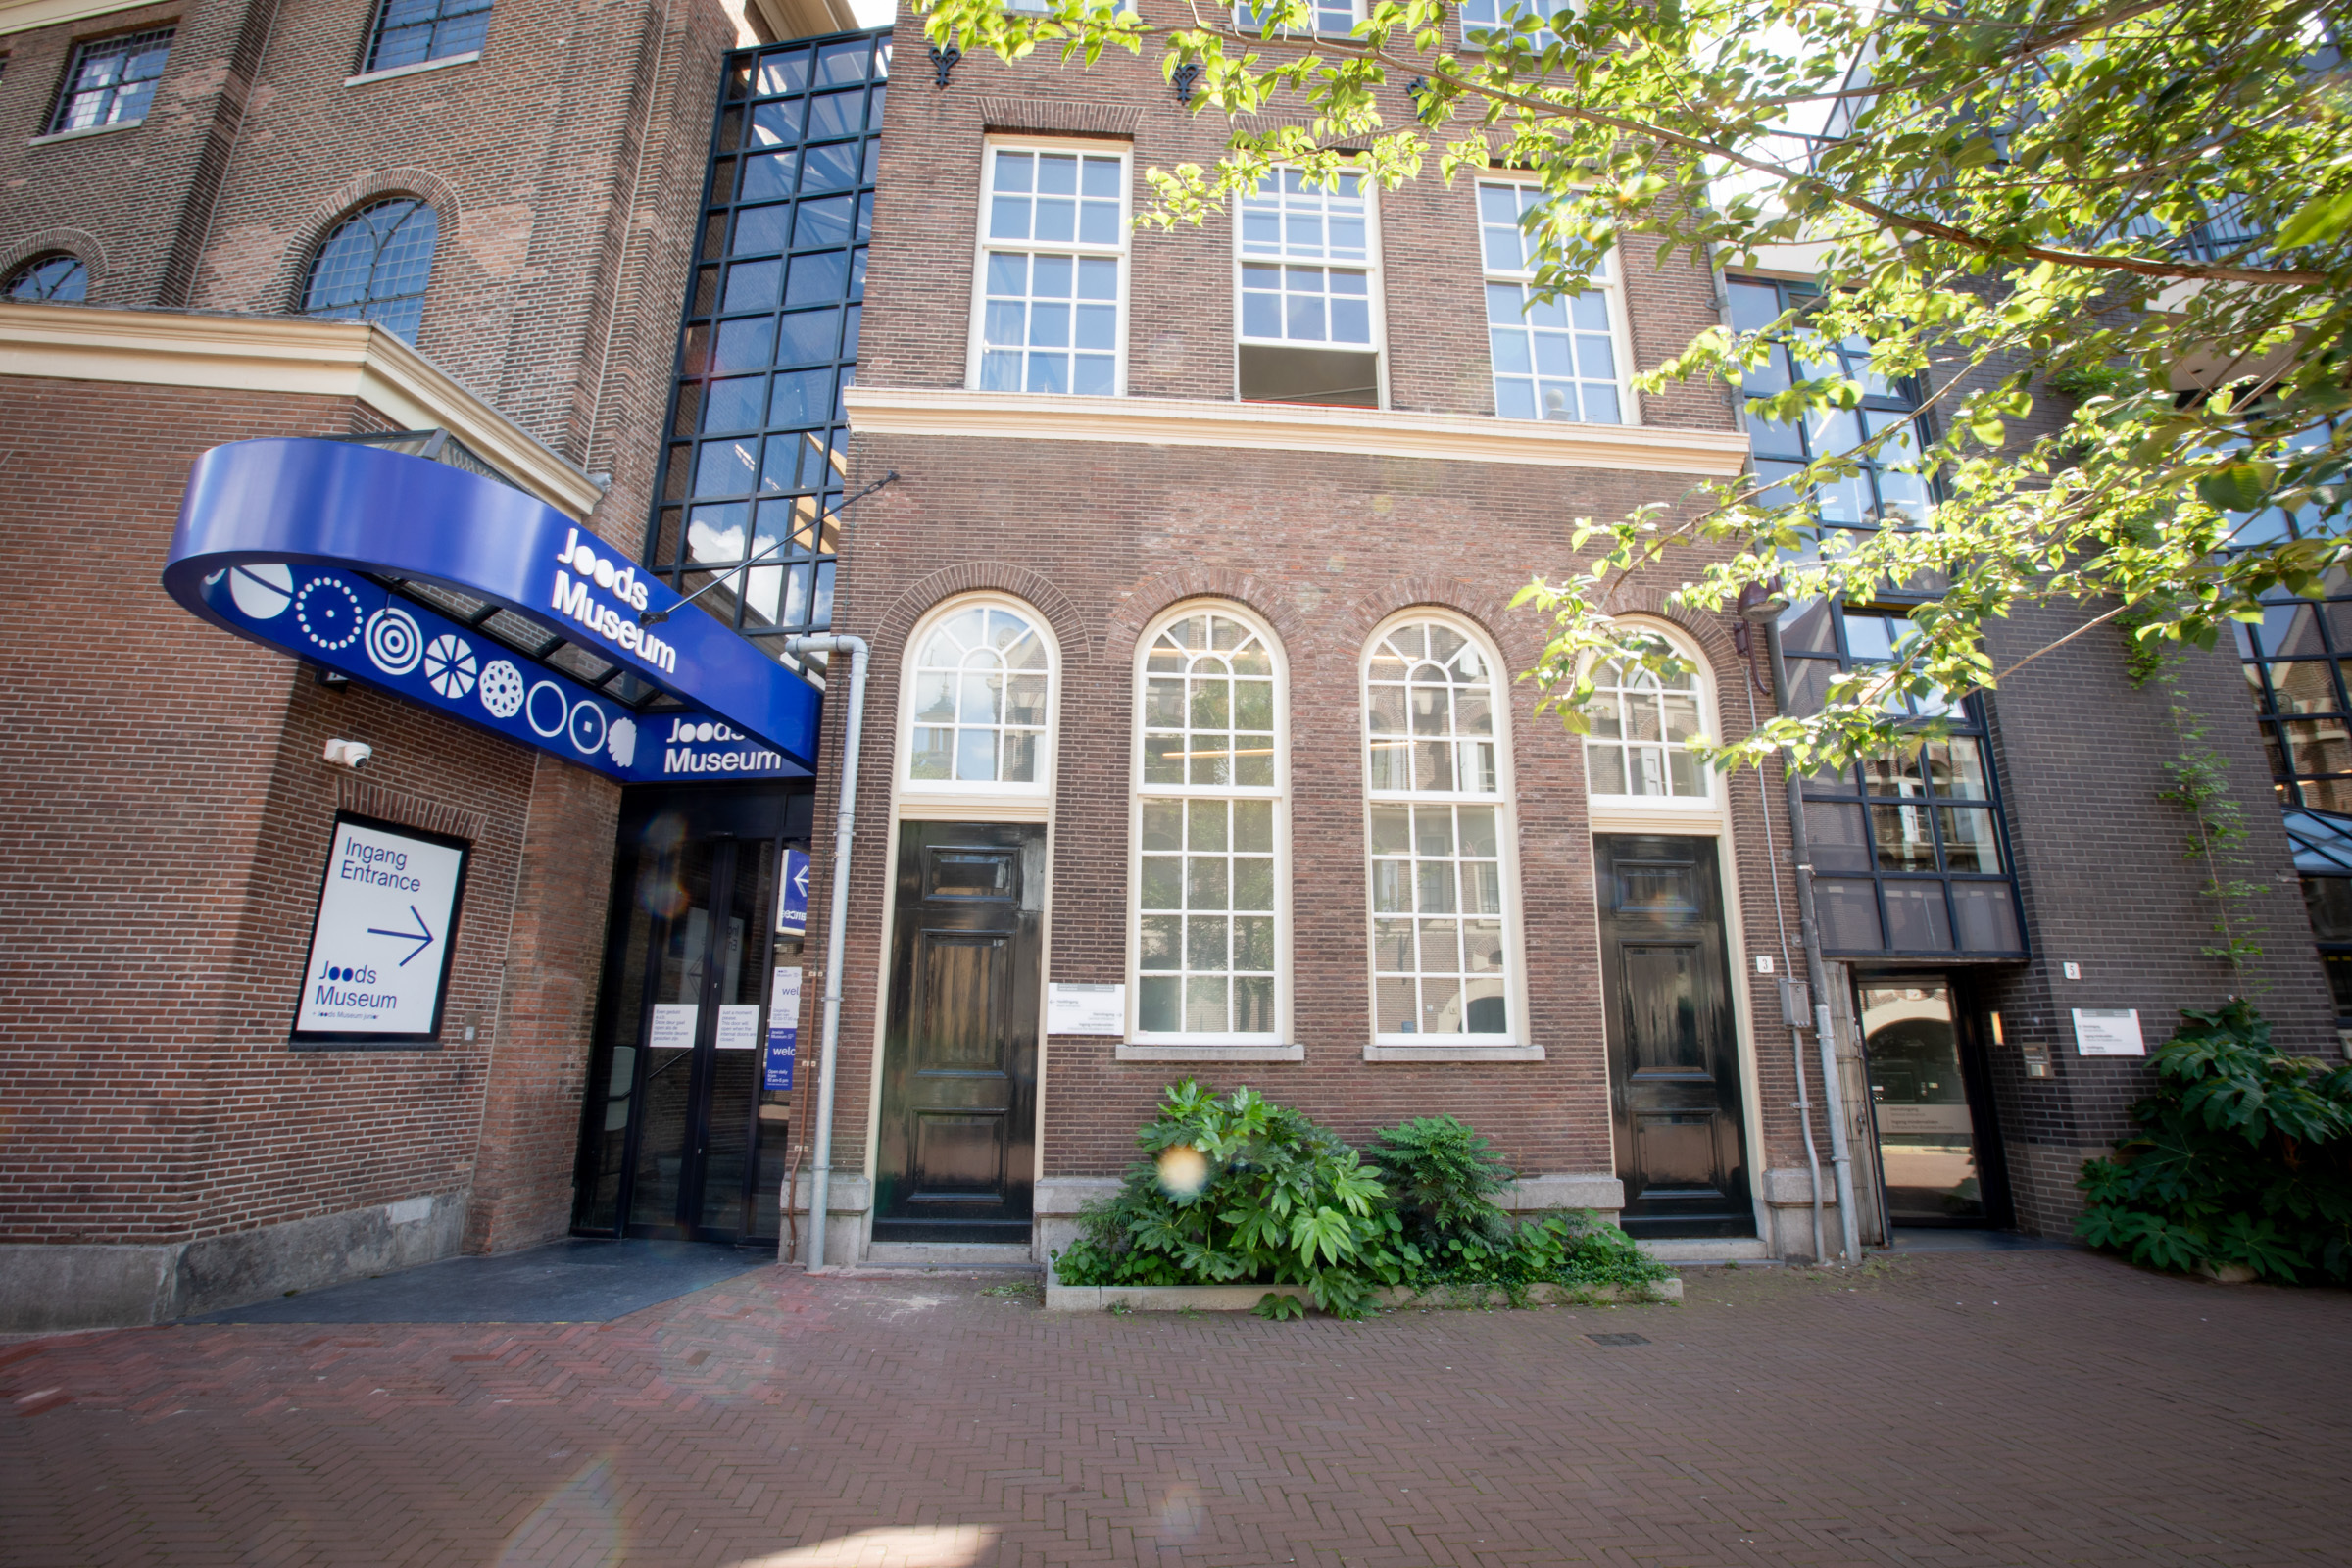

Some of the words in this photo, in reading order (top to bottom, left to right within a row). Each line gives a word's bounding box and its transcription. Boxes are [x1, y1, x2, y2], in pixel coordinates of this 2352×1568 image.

[557, 528, 648, 611] Joods
[552, 570, 676, 673] Museum
[664, 748, 782, 772] Museum
[345, 836, 407, 870] Ingang
[340, 860, 421, 892] Entrance
[318, 960, 377, 984] Joods
[1762, 958, 1768, 969] 3
[2069, 965, 2075, 976] 5
[315, 985, 397, 1009] Museum
[782, 987, 799, 996] wel
[773, 1046, 796, 1056] welc
